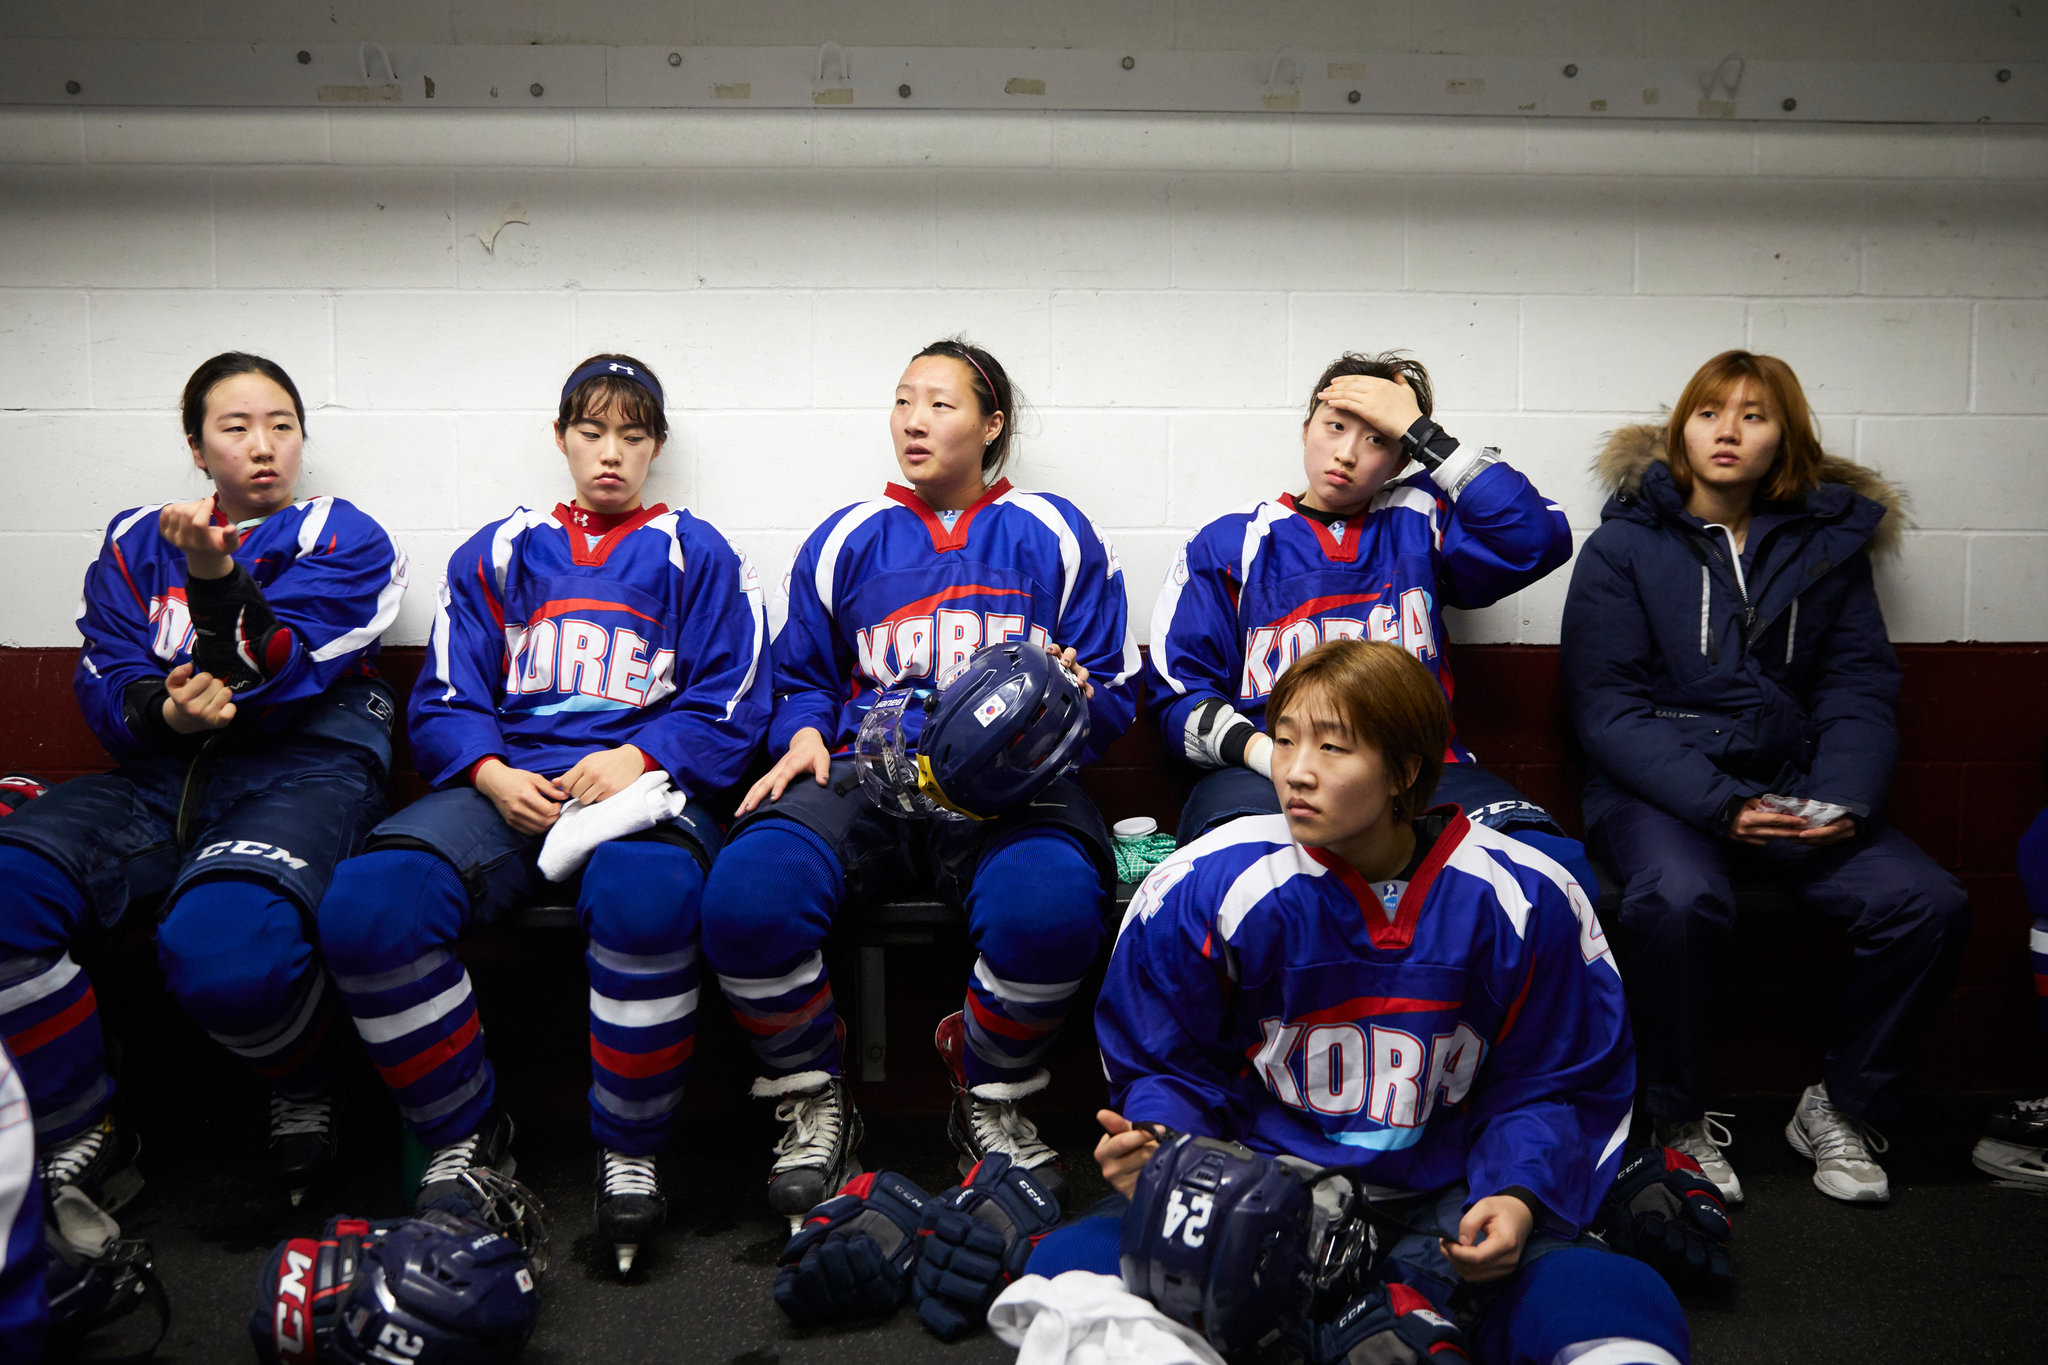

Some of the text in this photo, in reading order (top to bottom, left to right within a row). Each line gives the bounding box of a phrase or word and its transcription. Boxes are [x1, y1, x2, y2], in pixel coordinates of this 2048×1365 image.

[856, 608, 1050, 696] KOR
[196, 840, 309, 870] CCM
[1252, 1015, 1488, 1128] KORA
[1617, 1157, 1643, 1180] CCM
[893, 1184, 923, 1208] CCM
[1018, 1179, 1046, 1207] CCM
[276, 1249, 314, 1359] CM
[1339, 1300, 1367, 1329] CCM
